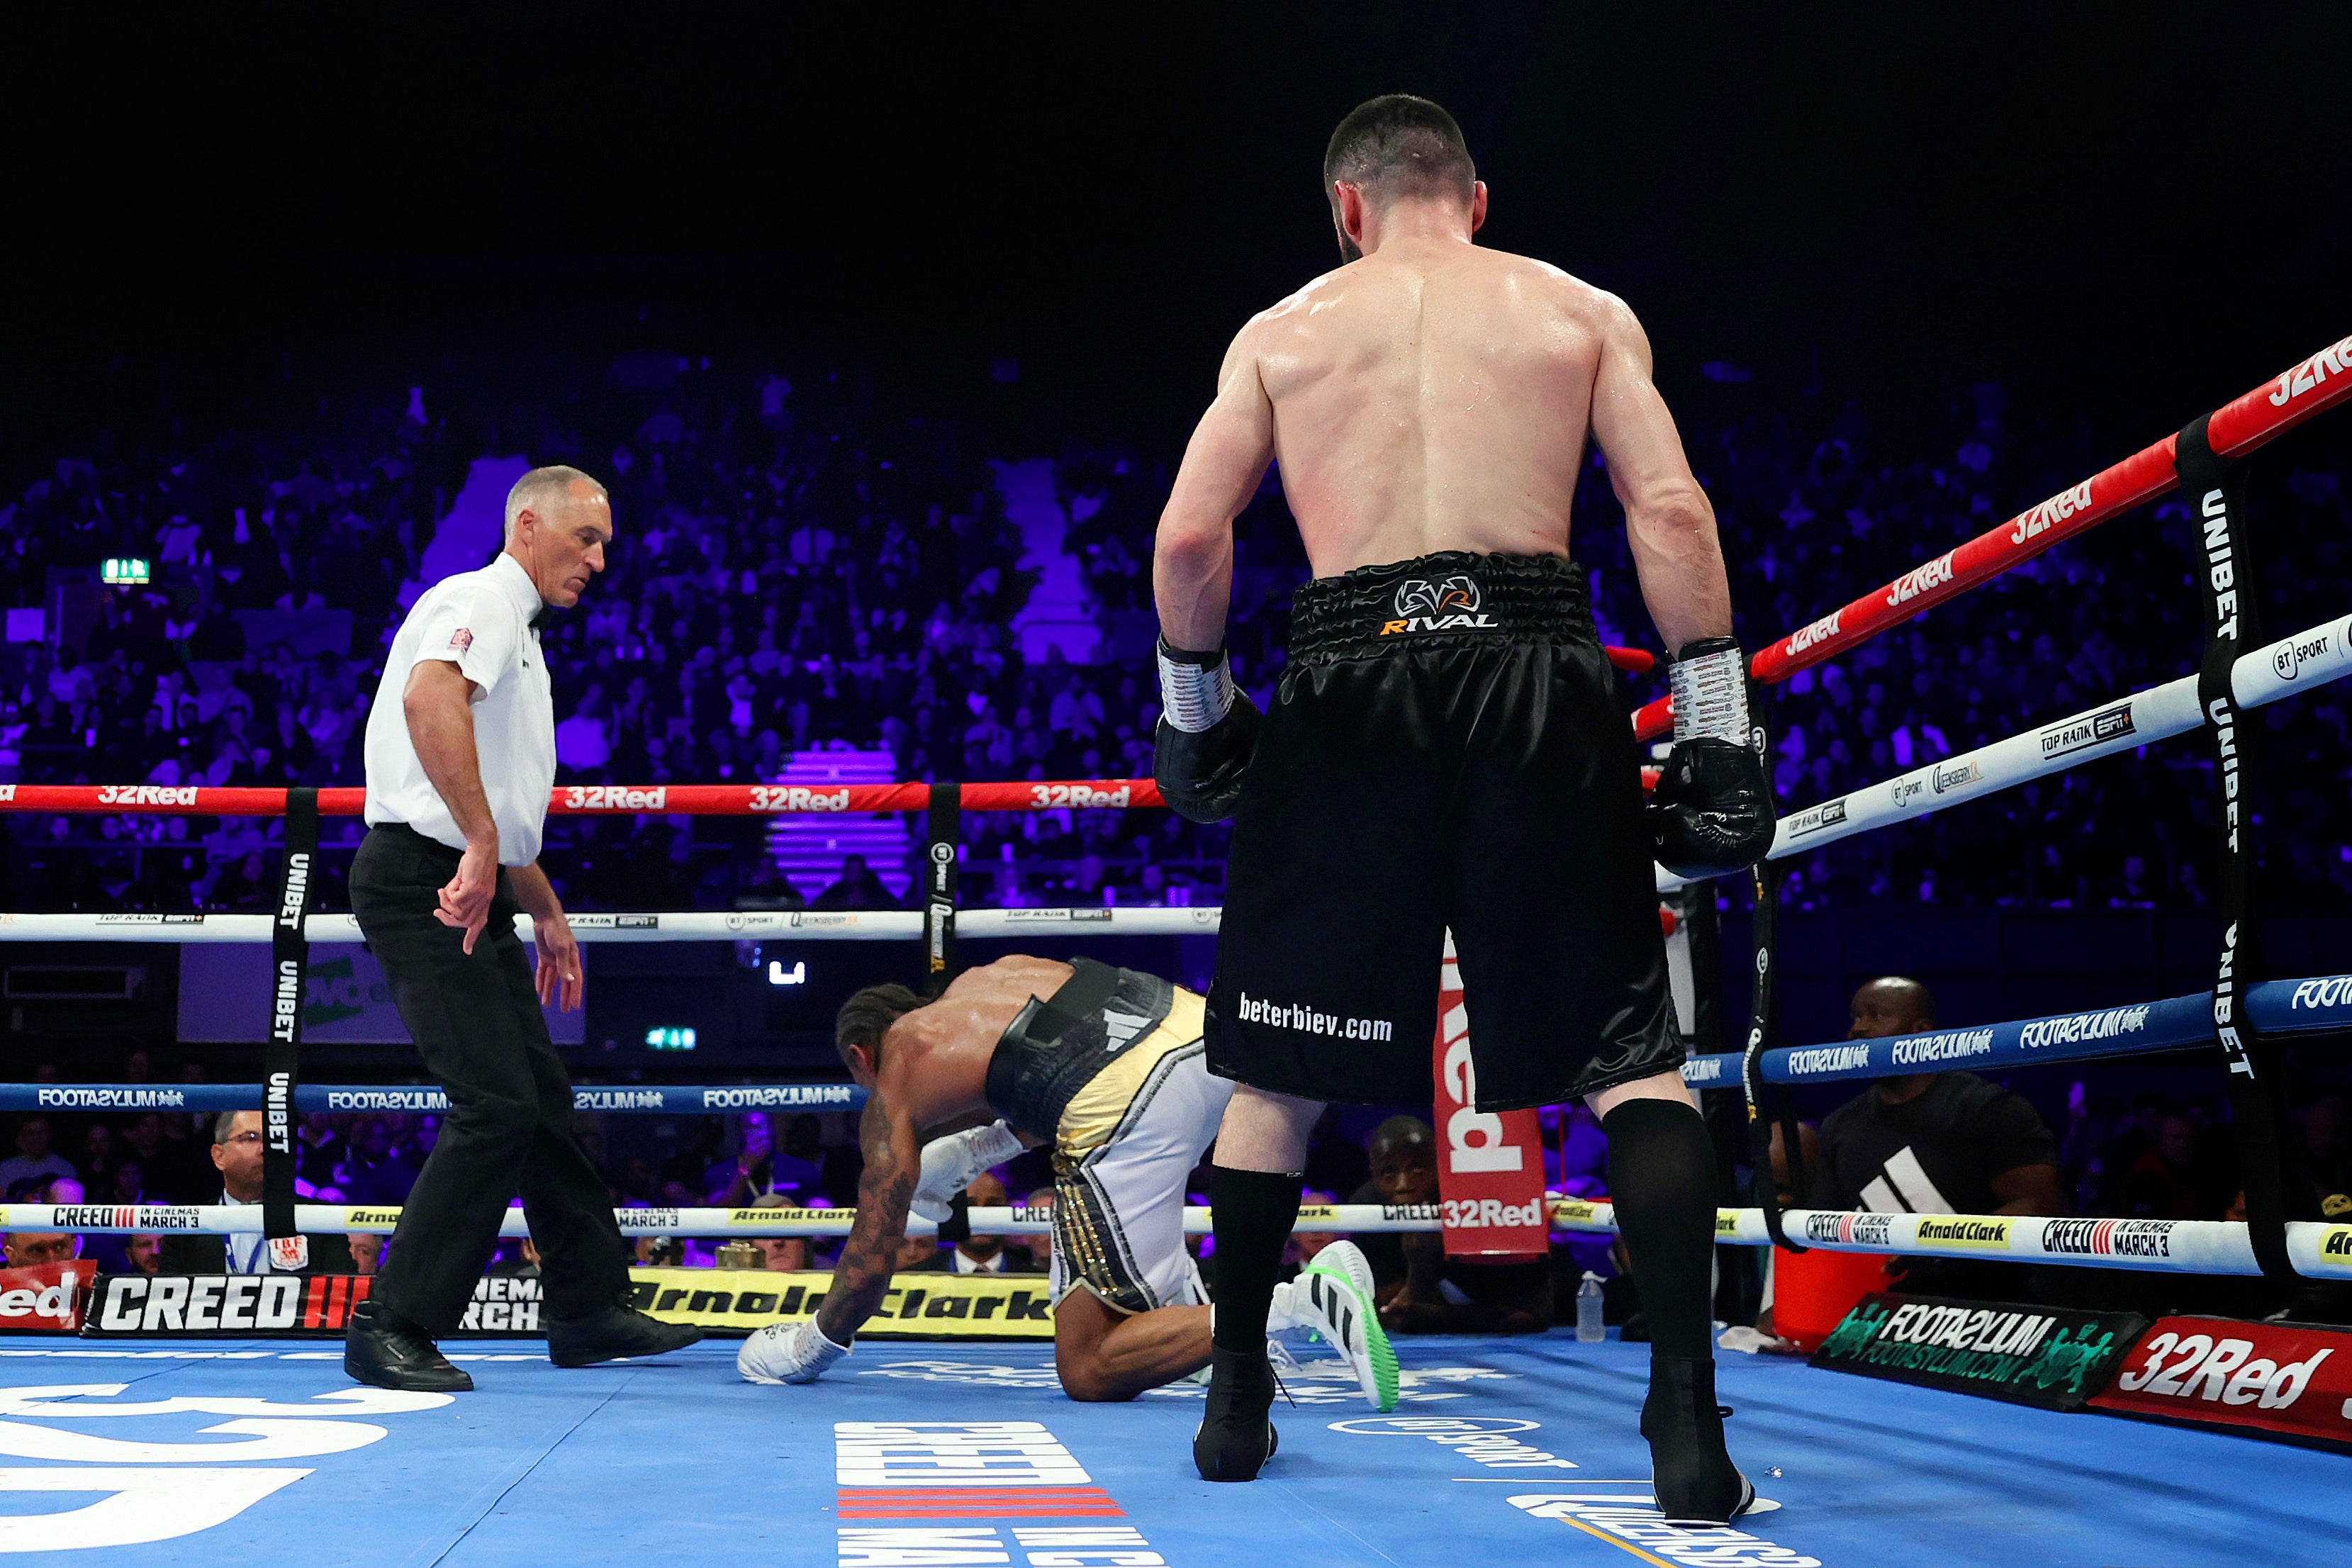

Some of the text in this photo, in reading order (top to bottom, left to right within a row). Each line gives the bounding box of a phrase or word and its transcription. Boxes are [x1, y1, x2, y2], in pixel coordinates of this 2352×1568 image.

[2202, 489, 2238, 641] UNIBET
[1379, 615, 1499, 636] RIVAL
[2298, 637, 2329, 663] SPORT
[2041, 733, 2060, 751] TOP
[2062, 723, 2093, 746] RANK
[2209, 698, 2239, 853] UNIBET
[98, 785, 198, 805] 32Red
[565, 786, 666, 810] 32Red
[749, 787, 849, 812] 32Red
[1031, 785, 1131, 807] 32Red
[280, 853, 310, 930] UNIBET
[274, 961, 298, 1043] UNIBET
[2214, 919, 2255, 1079] UNIBET
[1239, 992, 1393, 1042] beterbiev.com
[39, 1090, 156, 1107] FOOTASYLUM
[328, 1092, 447, 1109] FOOTASYLUM
[703, 1087, 825, 1108] FOOTASYLUM
[267, 1072, 290, 1154] UNIBET
[53, 1208, 113, 1227] CREED
[140, 1216, 199, 1228] MARCH 3
[350, 1211, 401, 1223] Arno
[619, 1215, 678, 1227] MARCH 3
[734, 1209, 856, 1221] Arnold Clark
[1299, 1206, 1331, 1216] ark
[1443, 1197, 1542, 1228] 32Red
[1918, 1221, 2007, 1241] Arnold Clark
[2042, 1220, 2098, 1253] CREED
[2114, 1234, 2169, 1258] MARCH 3
[101, 1277, 302, 1331] CREED
[1879, 1304, 2057, 1357] FOOTASYLUM
[2118, 1332, 2335, 1410] 32Red
[833, 1421, 1092, 1486] CREED
[1426, 1434, 1580, 1468] SPORT
